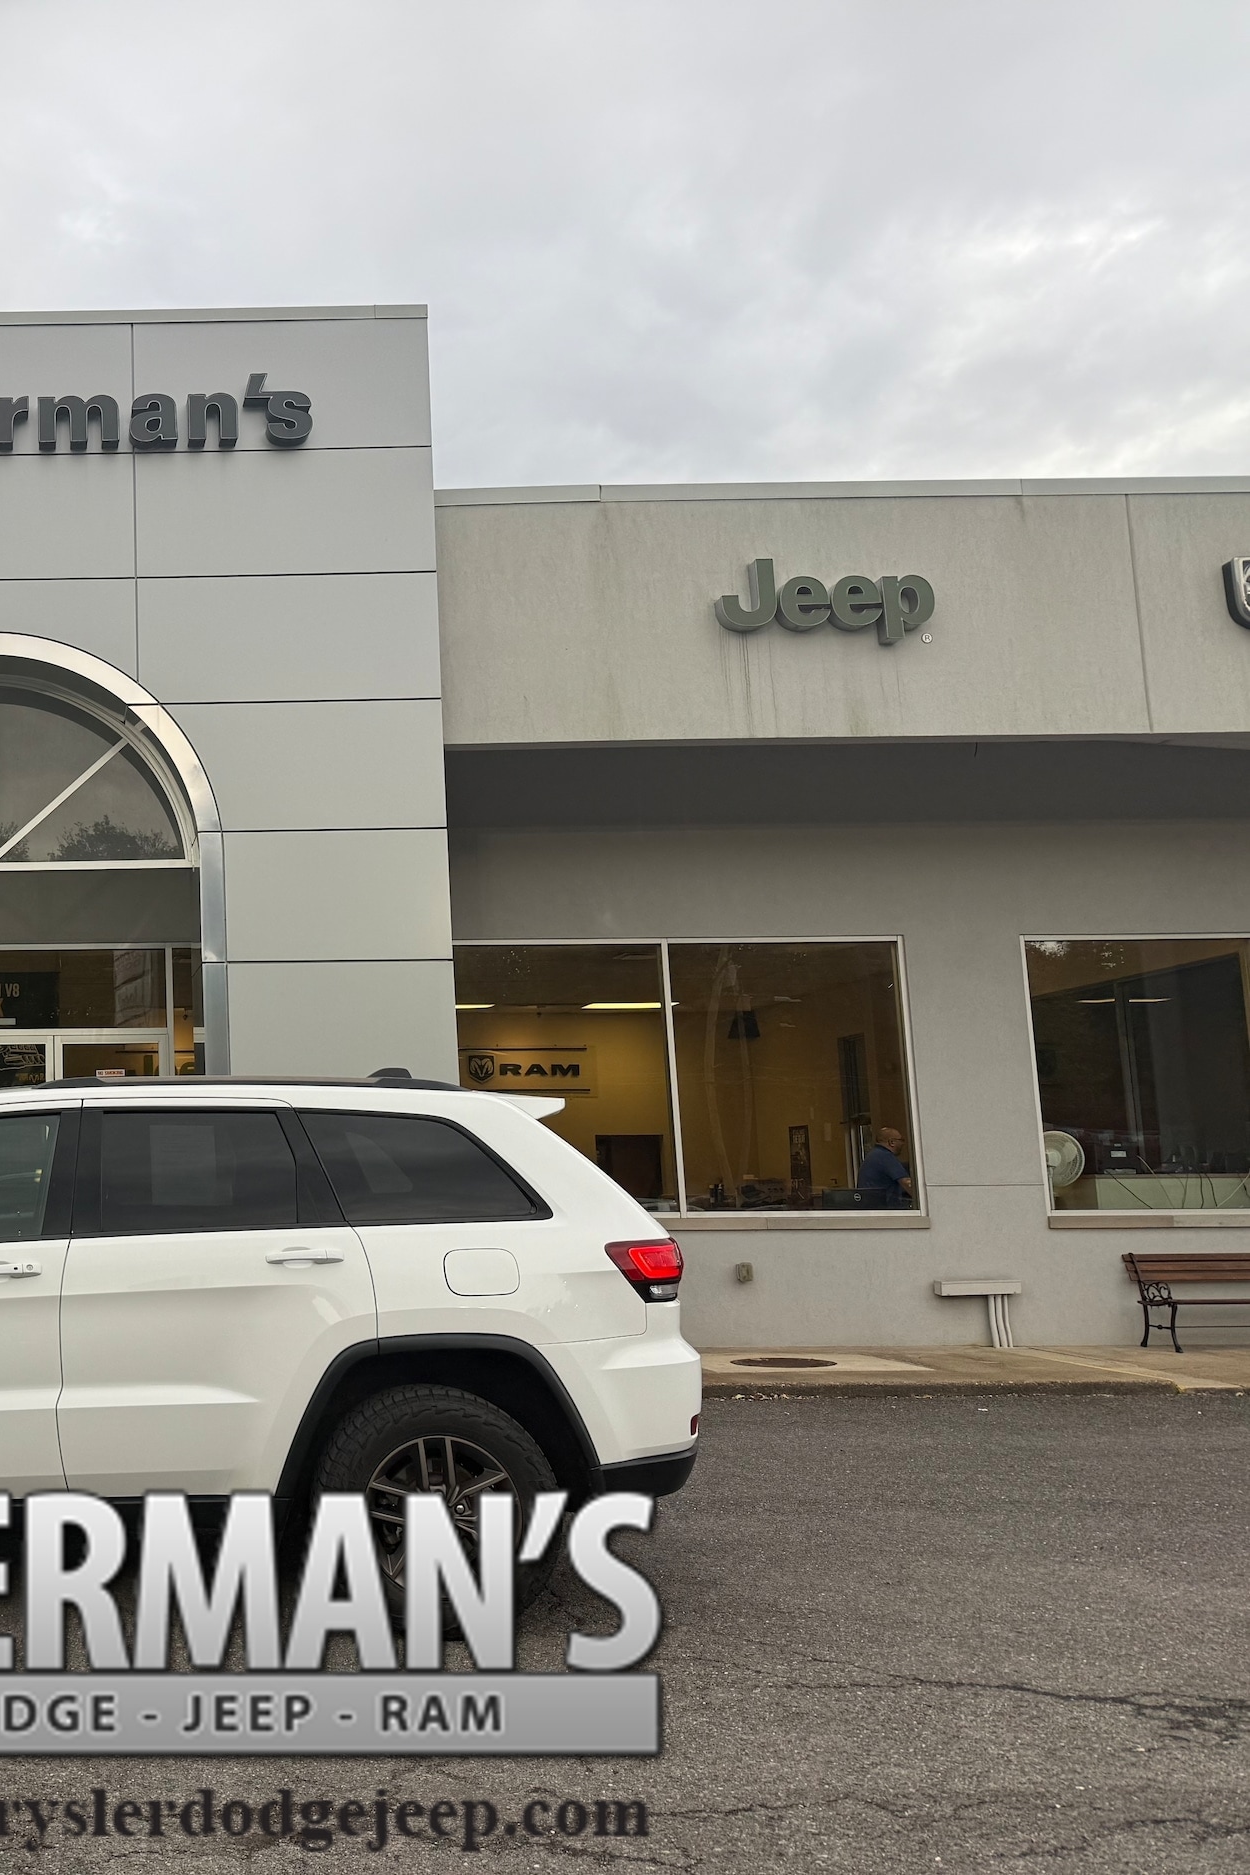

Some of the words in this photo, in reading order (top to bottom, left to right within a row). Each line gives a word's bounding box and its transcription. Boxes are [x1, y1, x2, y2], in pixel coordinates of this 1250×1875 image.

[714, 558, 936, 646] Jeep
[5, 983, 20, 997] V8
[499, 1063, 580, 1076] RAM
